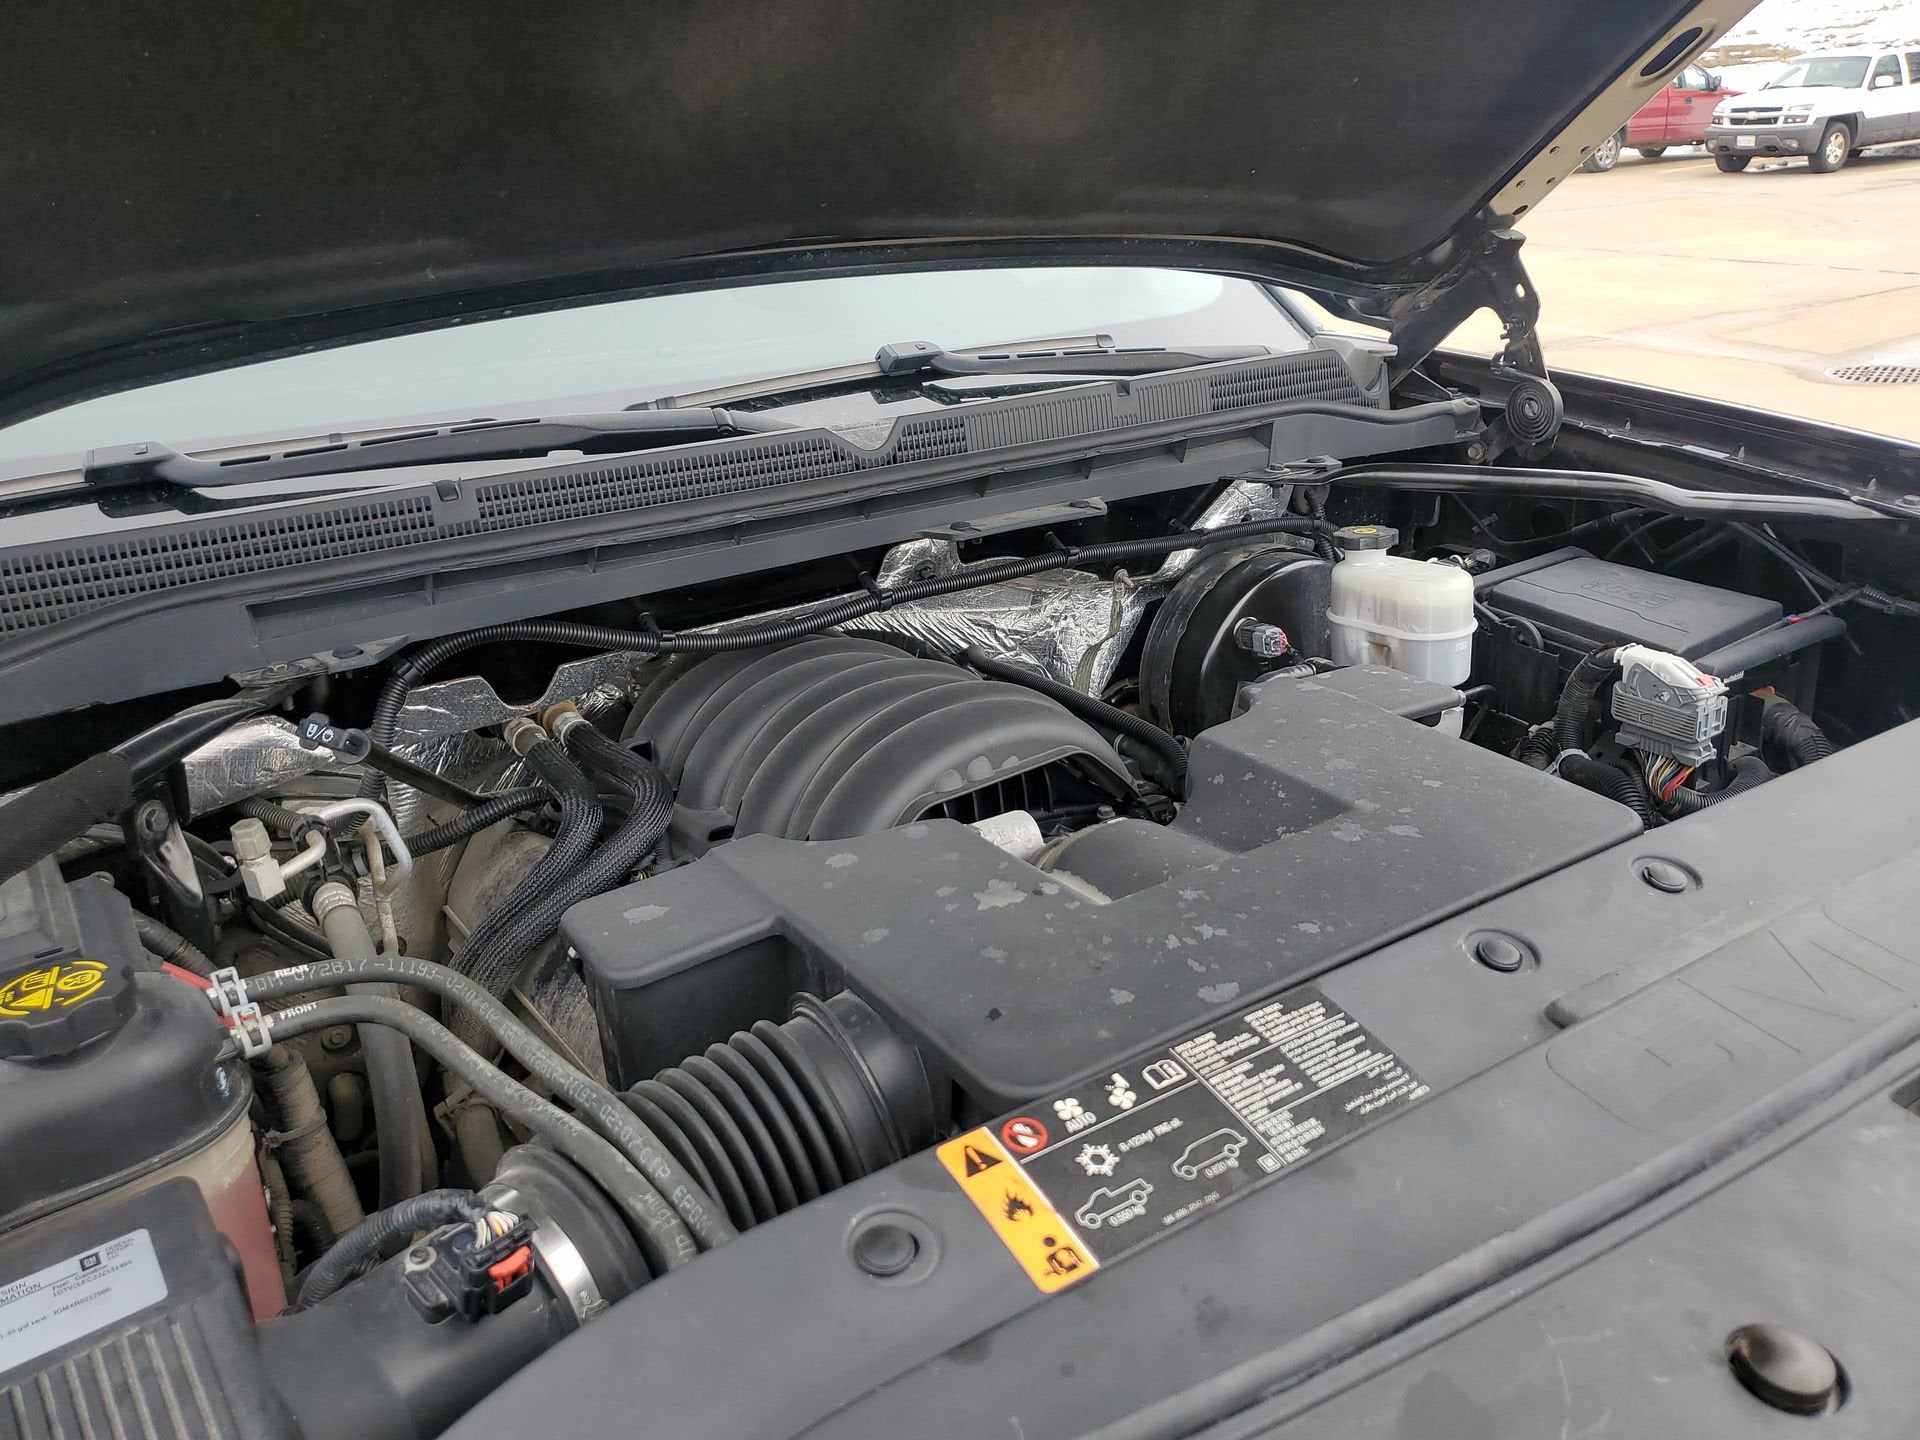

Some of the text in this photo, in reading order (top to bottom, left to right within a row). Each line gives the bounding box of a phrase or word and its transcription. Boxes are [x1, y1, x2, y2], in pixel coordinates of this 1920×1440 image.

[274, 964, 311, 978] REAR
[279, 1001, 319, 1020] FRONT
[1065, 1111, 1097, 1133] AUTO
[0, 1282, 41, 1305] MATION
